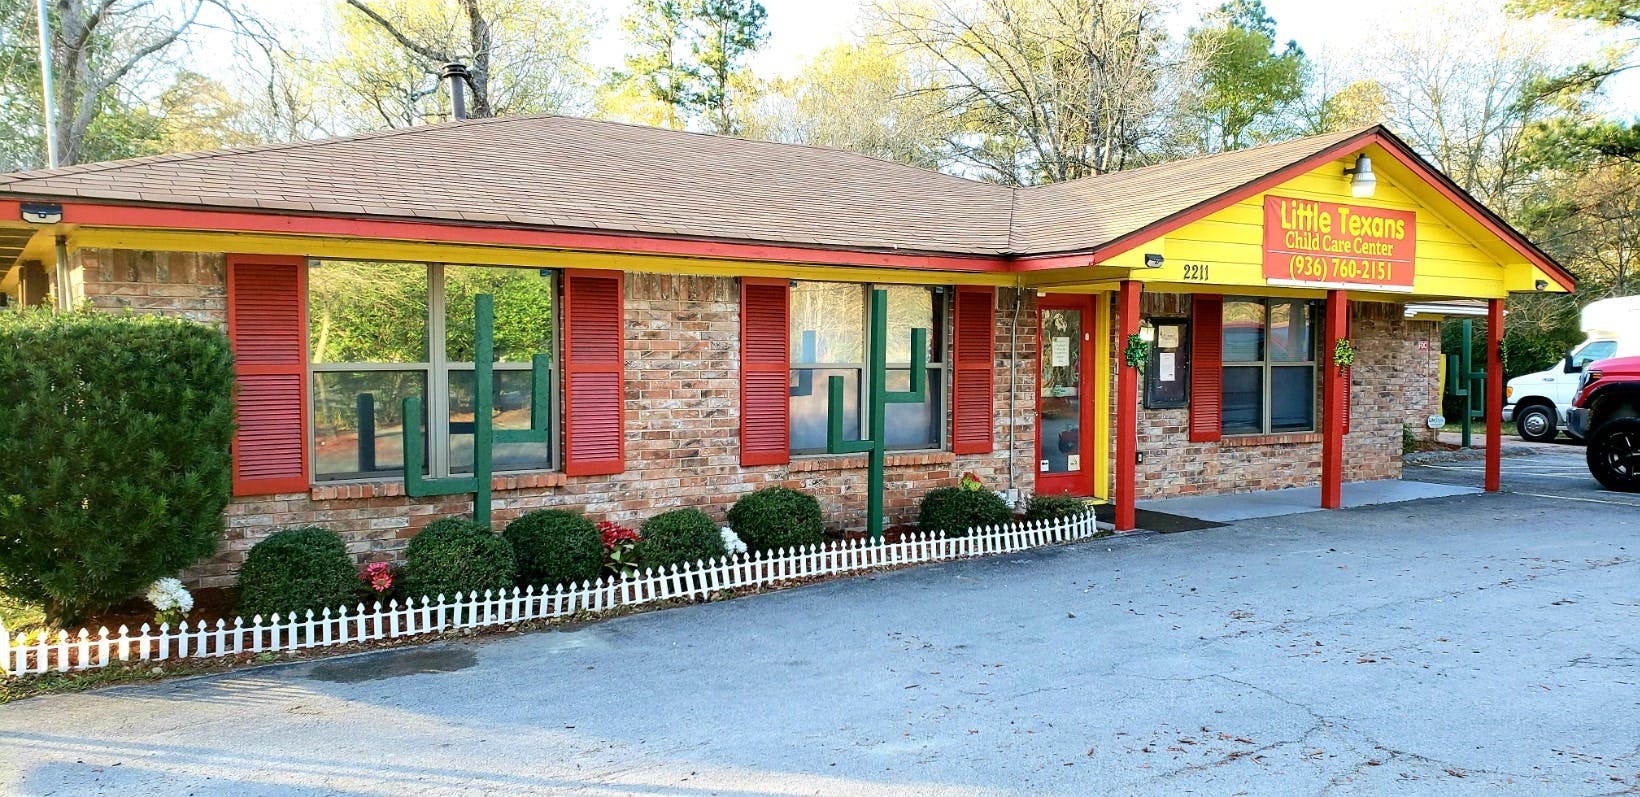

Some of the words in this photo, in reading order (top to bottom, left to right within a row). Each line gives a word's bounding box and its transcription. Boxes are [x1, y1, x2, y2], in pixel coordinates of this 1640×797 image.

[1281, 200, 1331, 233] Little
[1338, 207, 1405, 240] Texans
[1285, 231, 1320, 251] Child
[1322, 235, 1351, 253] Care
[1353, 238, 1393, 256] Center
[1184, 264, 1208, 280] 2211
[1290, 255, 1327, 281] (936)
[1332, 259, 1392, 280] 760-2151
